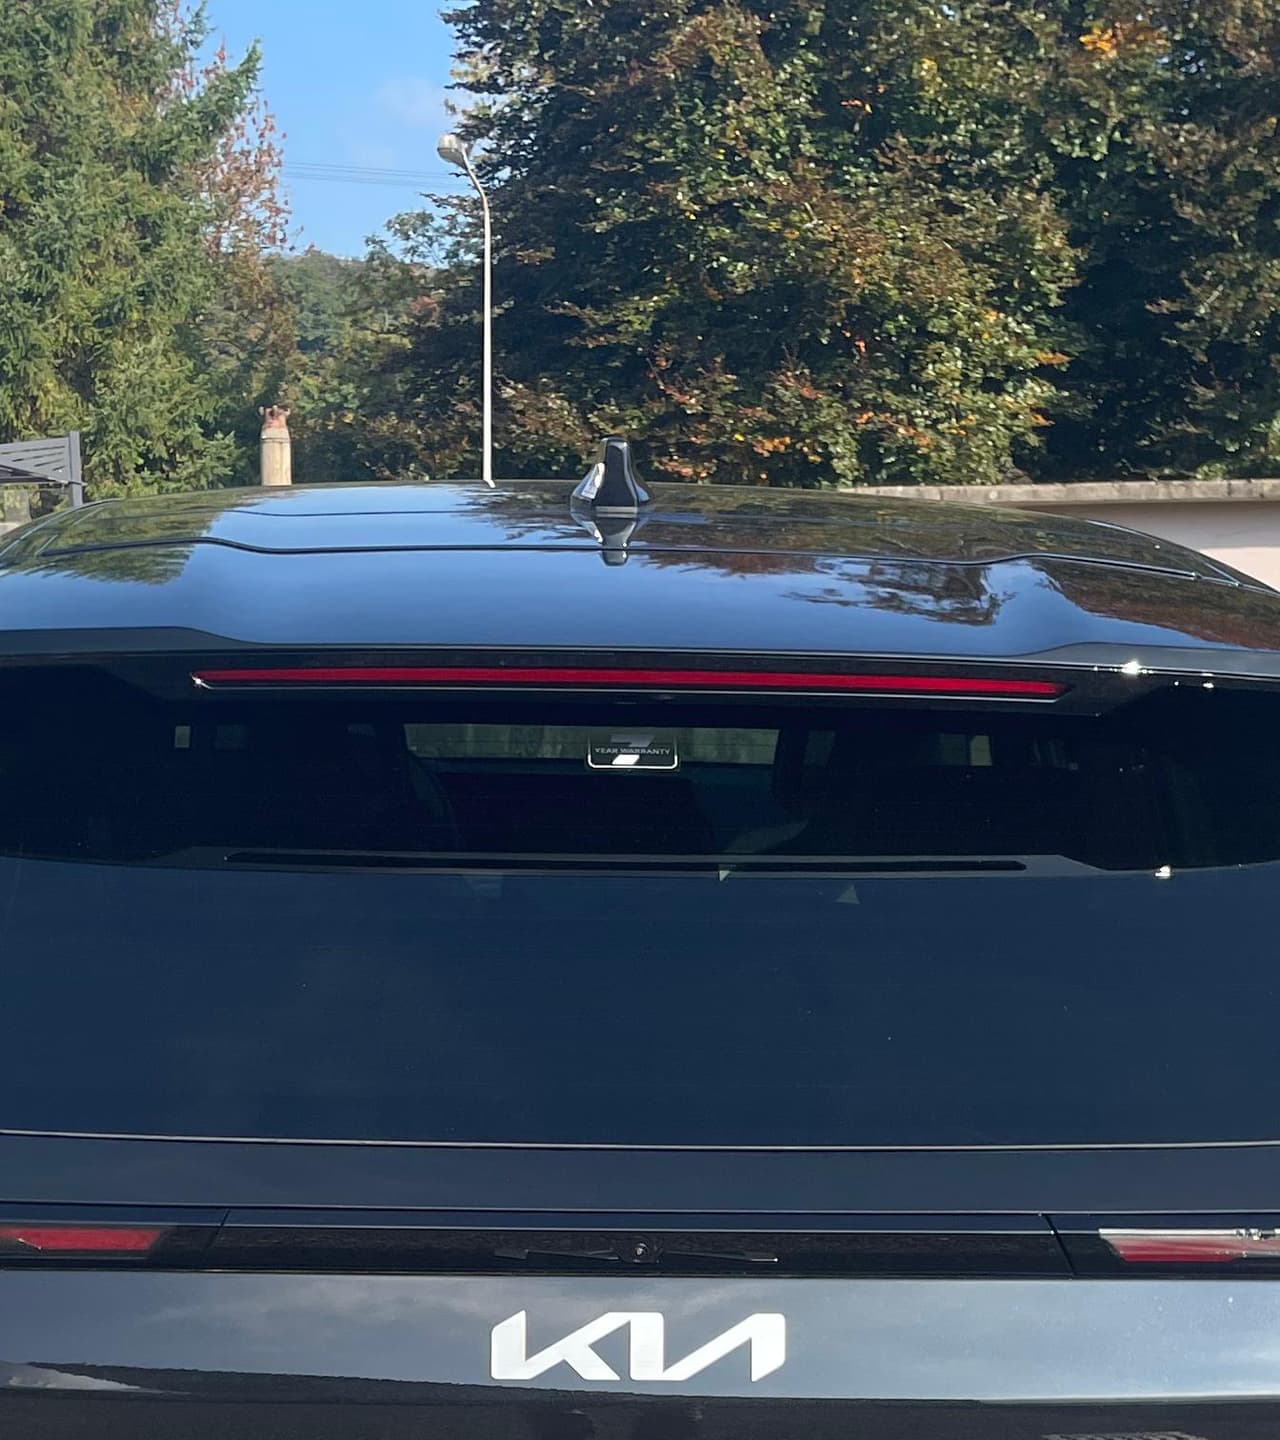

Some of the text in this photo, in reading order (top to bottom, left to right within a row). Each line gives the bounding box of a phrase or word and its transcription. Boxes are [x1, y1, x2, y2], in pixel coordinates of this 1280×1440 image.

[595, 747, 671, 756] YEAR WARRANTY
[490, 1309, 786, 1382] KIA
